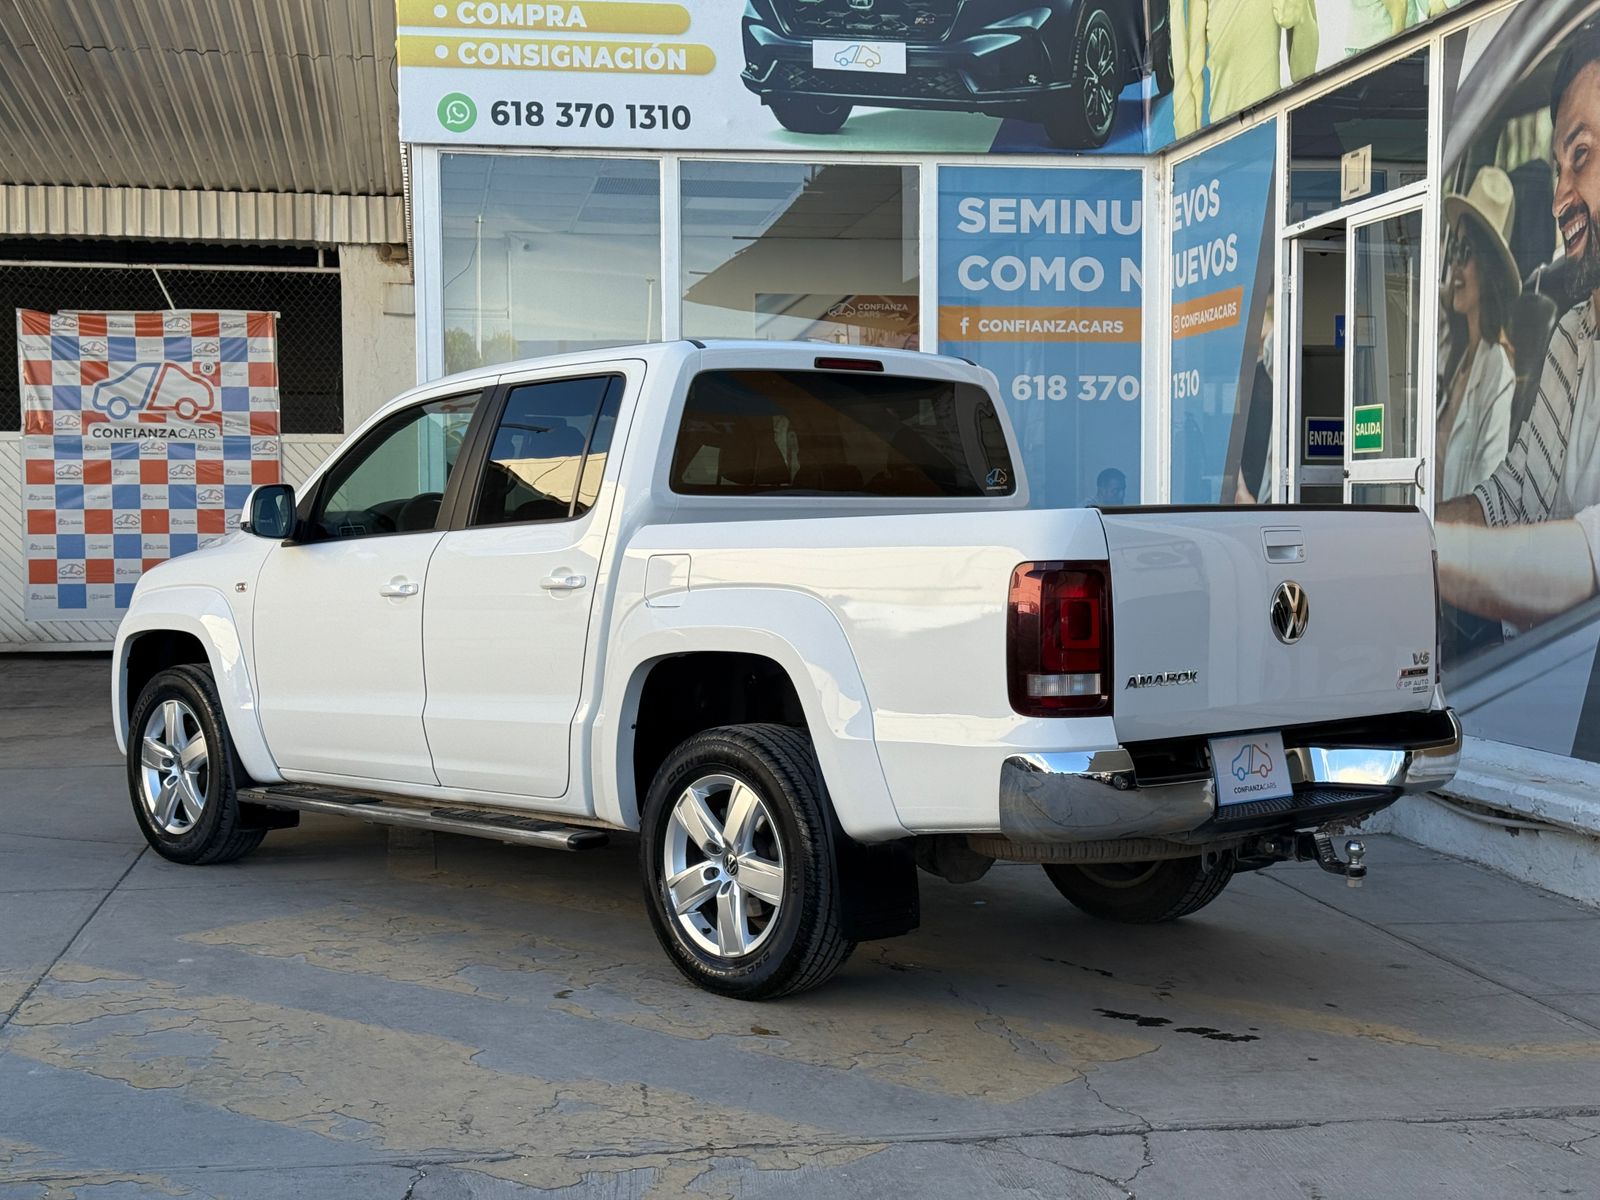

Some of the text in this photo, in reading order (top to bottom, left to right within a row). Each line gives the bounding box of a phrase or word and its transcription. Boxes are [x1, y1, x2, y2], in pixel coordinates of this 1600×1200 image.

[457, 2, 587, 28] COMPRA
[457, 42, 687, 70] CONSIGNACIÓN
[490, 100, 691, 130] 618 370 1310
[957, 197, 1143, 235] SEMINU
[958, 255, 1104, 292] COMO
[857, 303, 908, 311] CONFIANZA
[1180, 301, 1237, 329] CONFIANZACARS
[978, 319, 1124, 334] CONFIANZACARS
[1012, 374, 1140, 402] 618 370
[1172, 369, 1199, 399] 1310
[92, 428, 216, 439] CONFIANZACARS
[1355, 421, 1381, 437] SALIDA
[1412, 651, 1430, 665] V6
[1124, 670, 1198, 690] AMAROK
[1233, 782, 1277, 794] CONFIANZACARS
